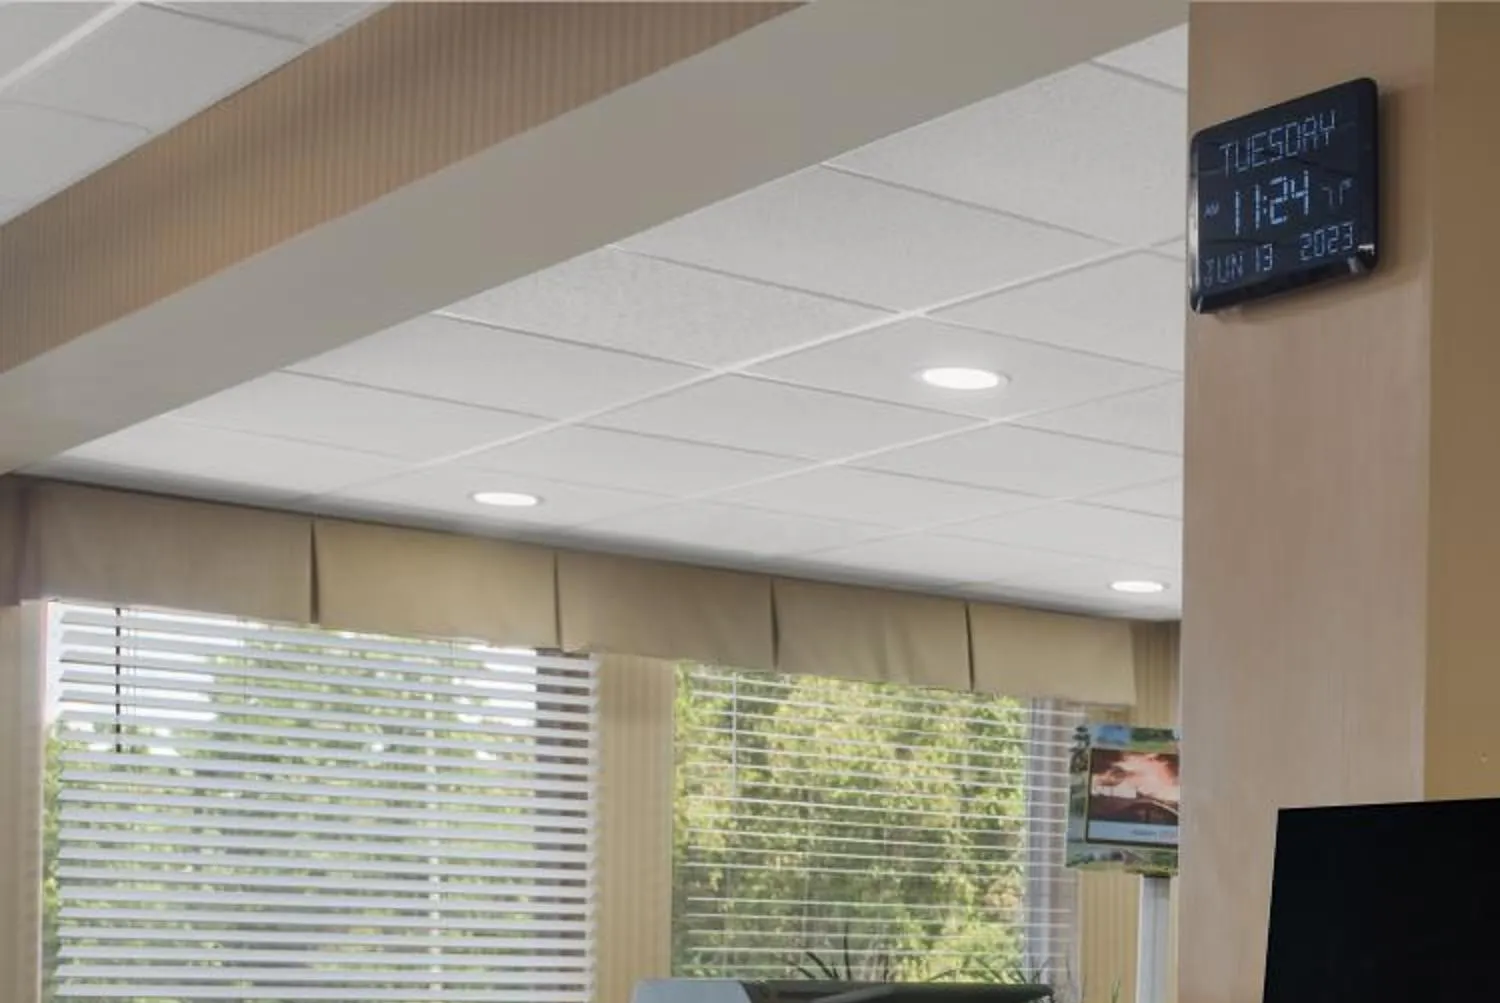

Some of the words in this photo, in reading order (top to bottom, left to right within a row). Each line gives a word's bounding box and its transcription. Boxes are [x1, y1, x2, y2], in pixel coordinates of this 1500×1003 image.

[1220, 109, 1336, 177] TUESDAY
[1235, 170, 1309, 236] 11:24
[1255, 243, 1273, 272] 13
[1300, 221, 1354, 261] 2023
